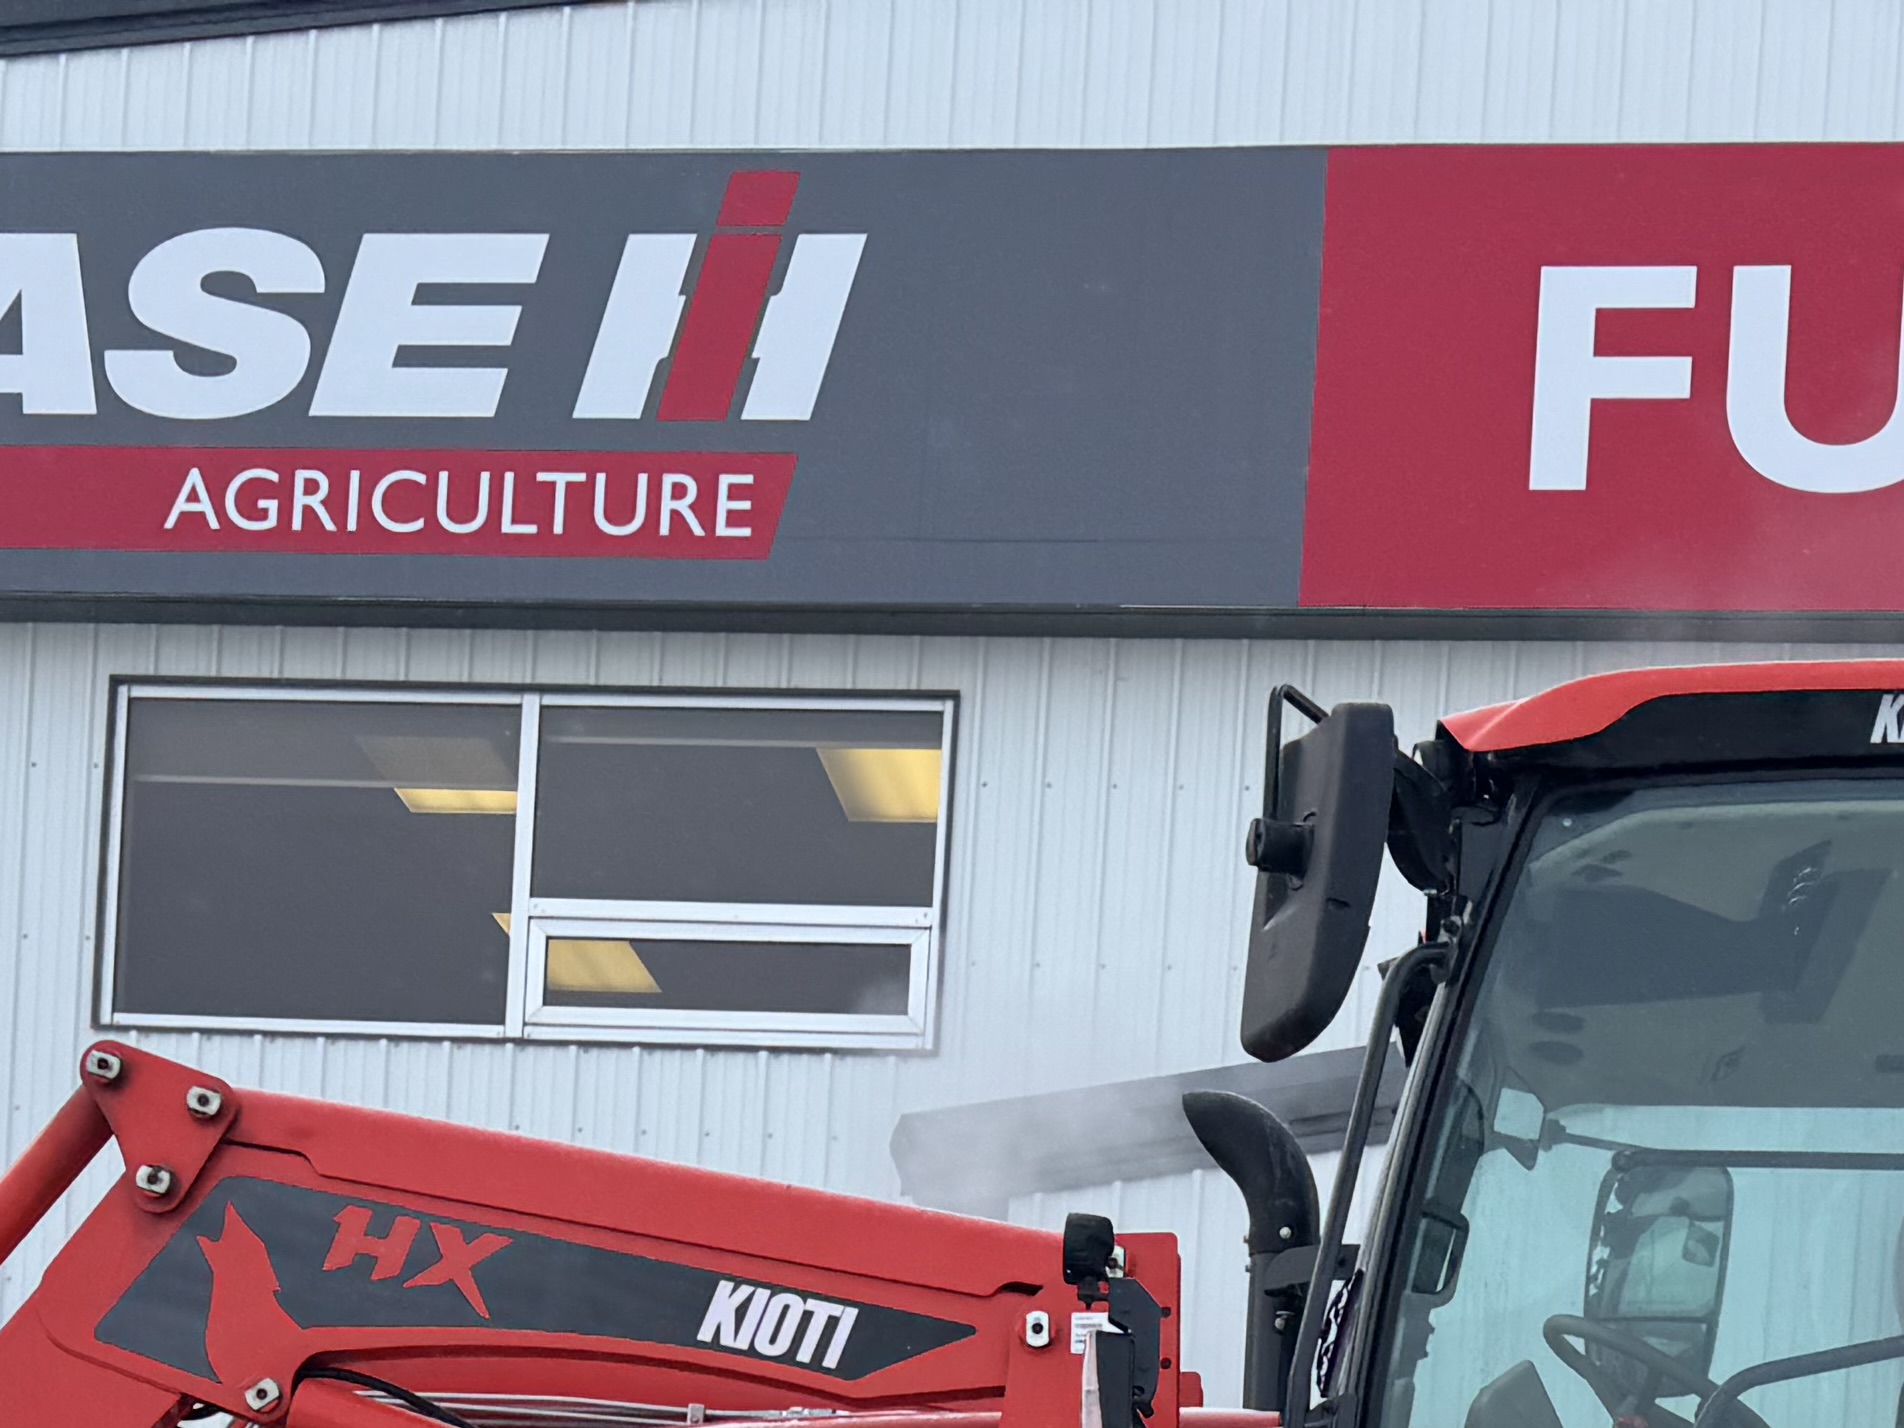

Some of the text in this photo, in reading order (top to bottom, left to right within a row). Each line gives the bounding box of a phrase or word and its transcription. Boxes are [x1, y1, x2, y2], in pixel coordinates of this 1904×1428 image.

[164, 467, 755, 540] AGRICULTURE
[322, 1205, 514, 1319] HX
[696, 1280, 859, 1370] KIOTI
